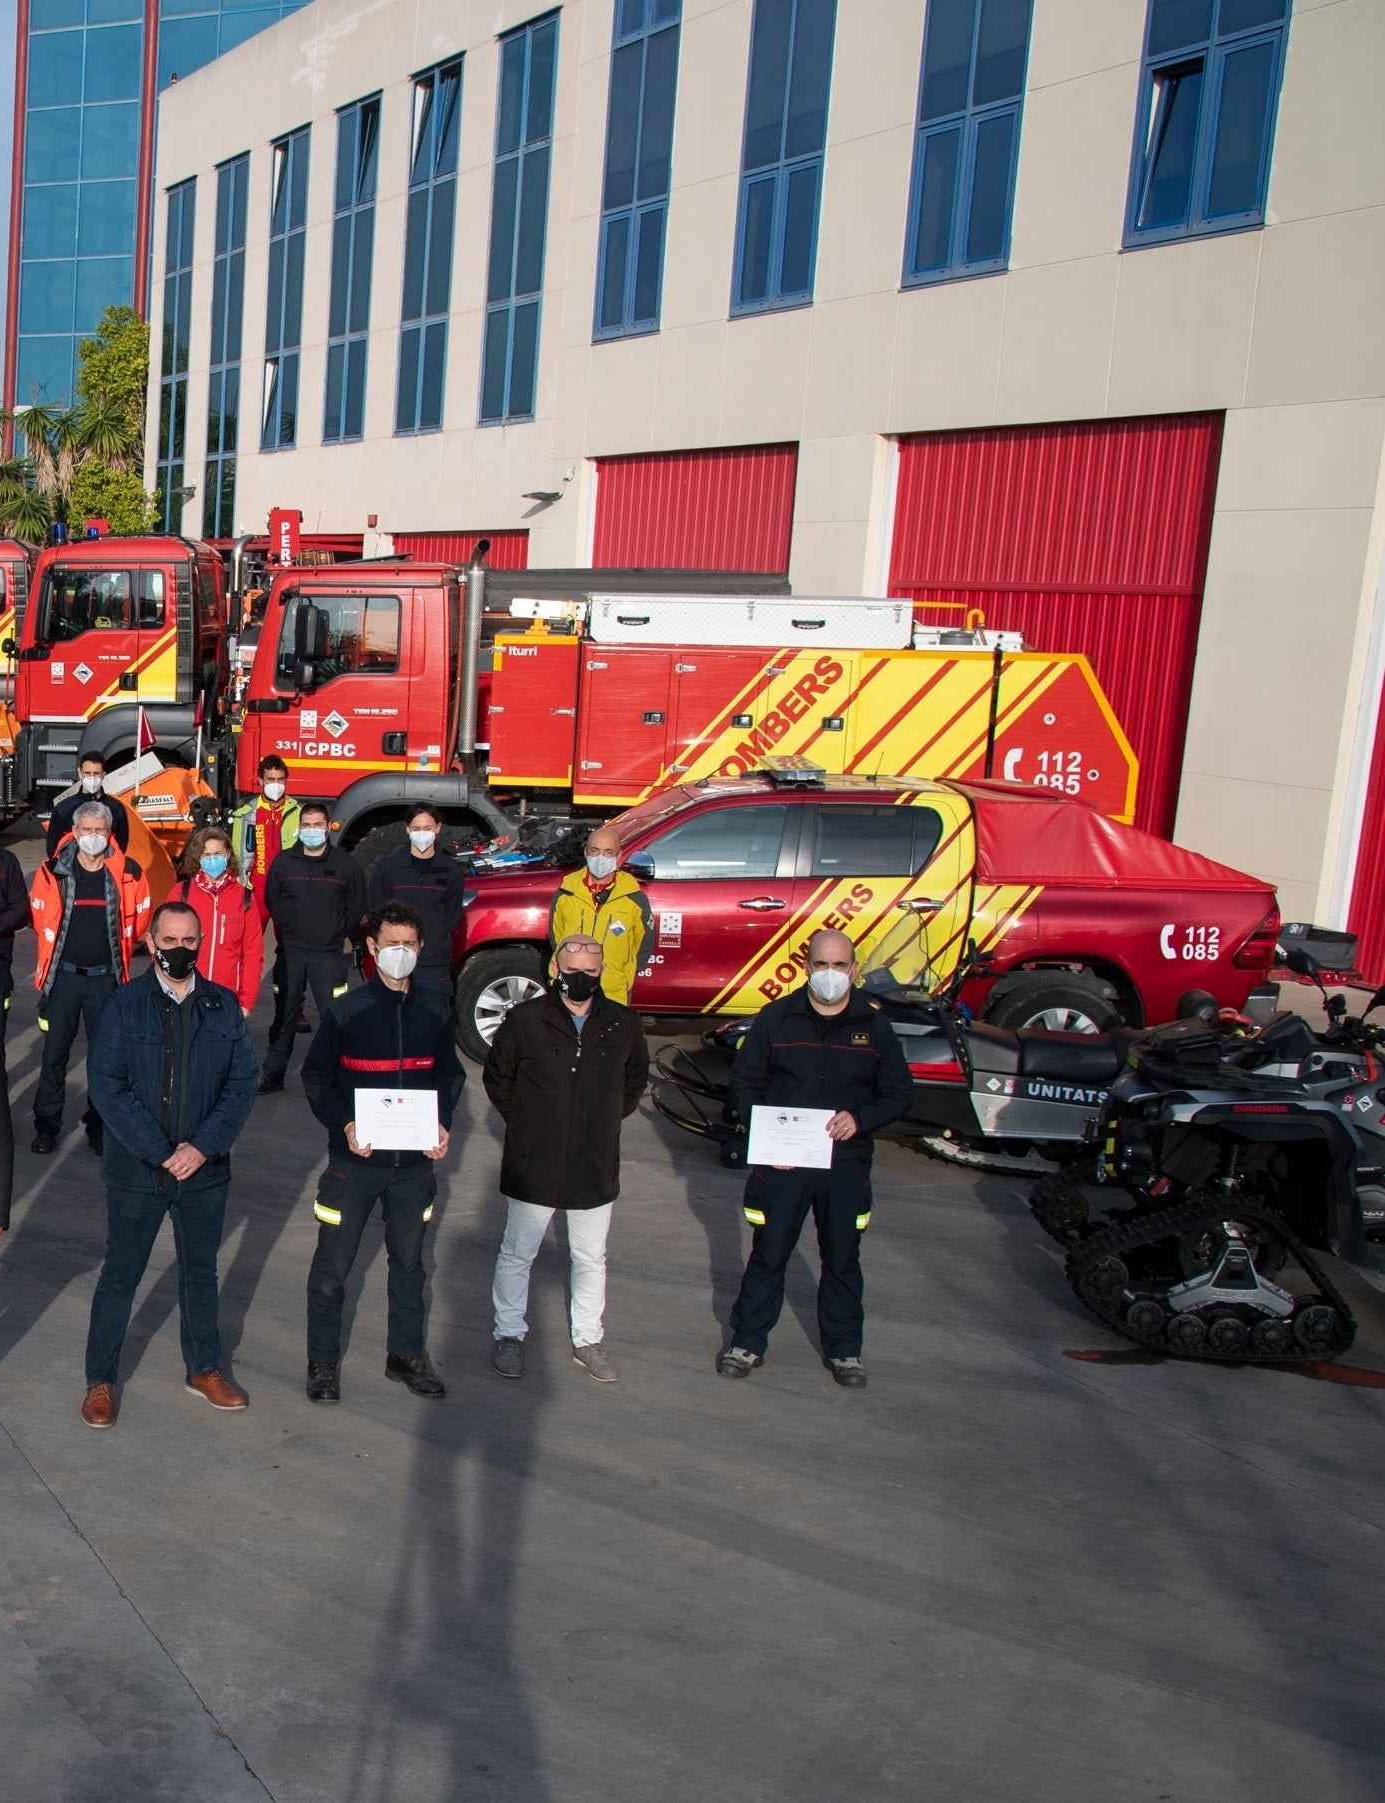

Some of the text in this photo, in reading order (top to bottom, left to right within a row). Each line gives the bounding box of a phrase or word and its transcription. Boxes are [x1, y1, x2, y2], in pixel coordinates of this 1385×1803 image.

[718, 655, 844, 777] OMBERS
[275, 740, 357, 758] 331 CPBC
[1037, 751, 1082, 773] 112
[255, 824, 266, 875] BOMBERS
[757, 883, 874, 1001] BOMERS
[1185, 926, 1220, 943] 112
[1182, 943, 1220, 960] 085
[1027, 1082, 1108, 1104] UNITATS
[1233, 1105, 1288, 1113] BOMBERS
